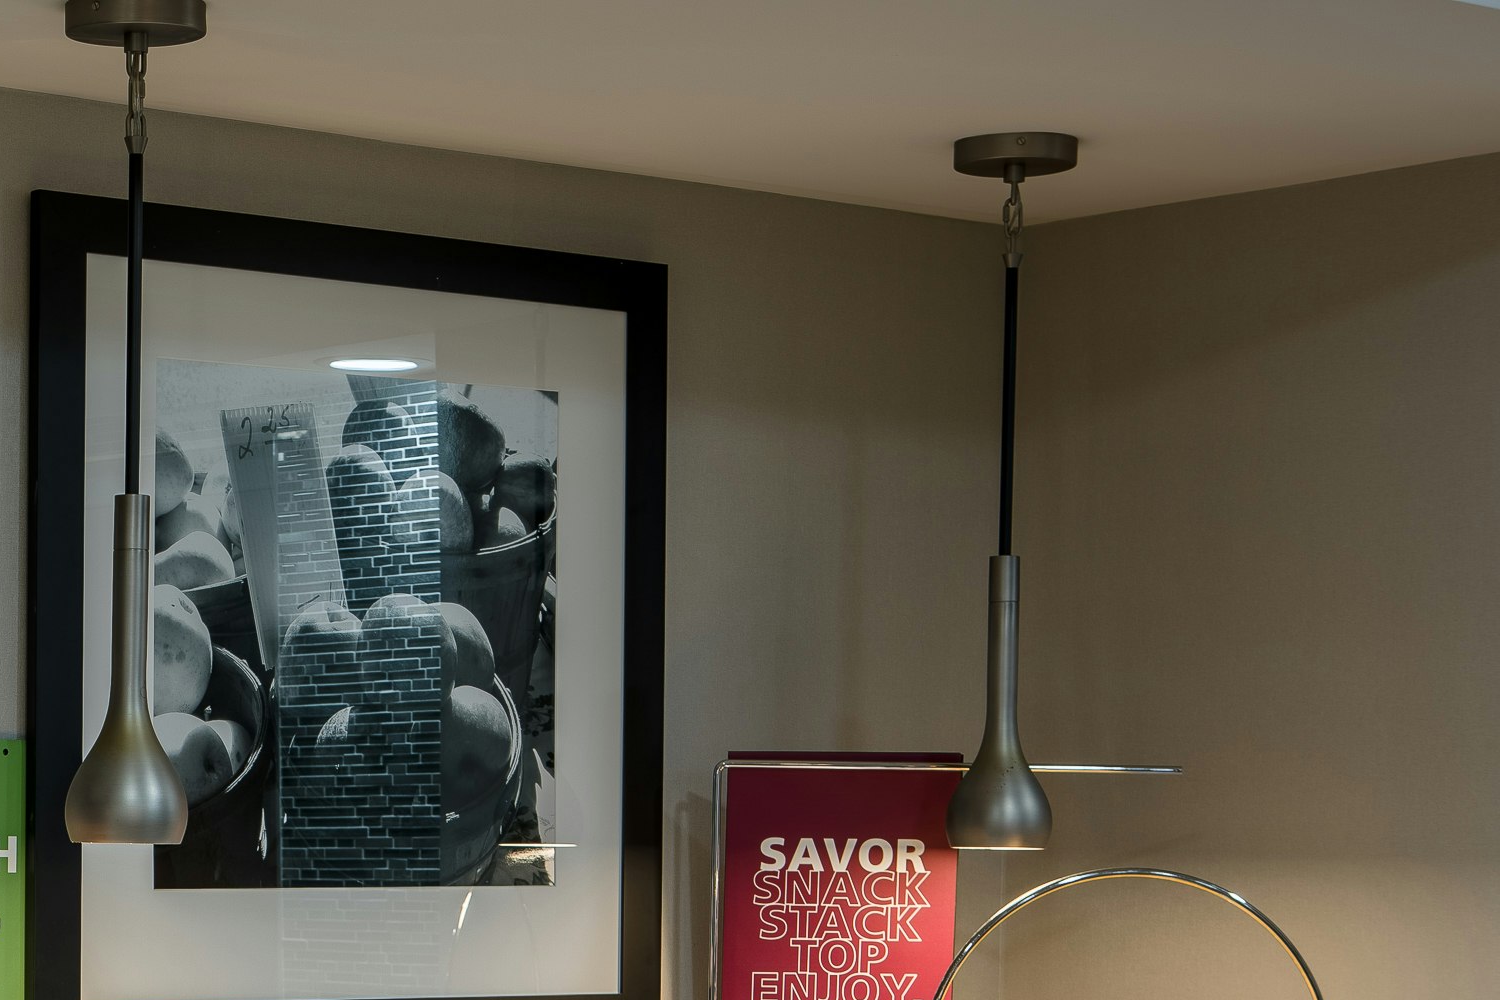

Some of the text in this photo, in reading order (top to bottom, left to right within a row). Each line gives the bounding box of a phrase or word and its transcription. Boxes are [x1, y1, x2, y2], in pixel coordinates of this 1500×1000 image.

[760, 837, 926, 873] SAVOR
[753, 870, 931, 908] SNACK
[759, 904, 922, 942] STACK
[790, 938, 888, 975] TOP
